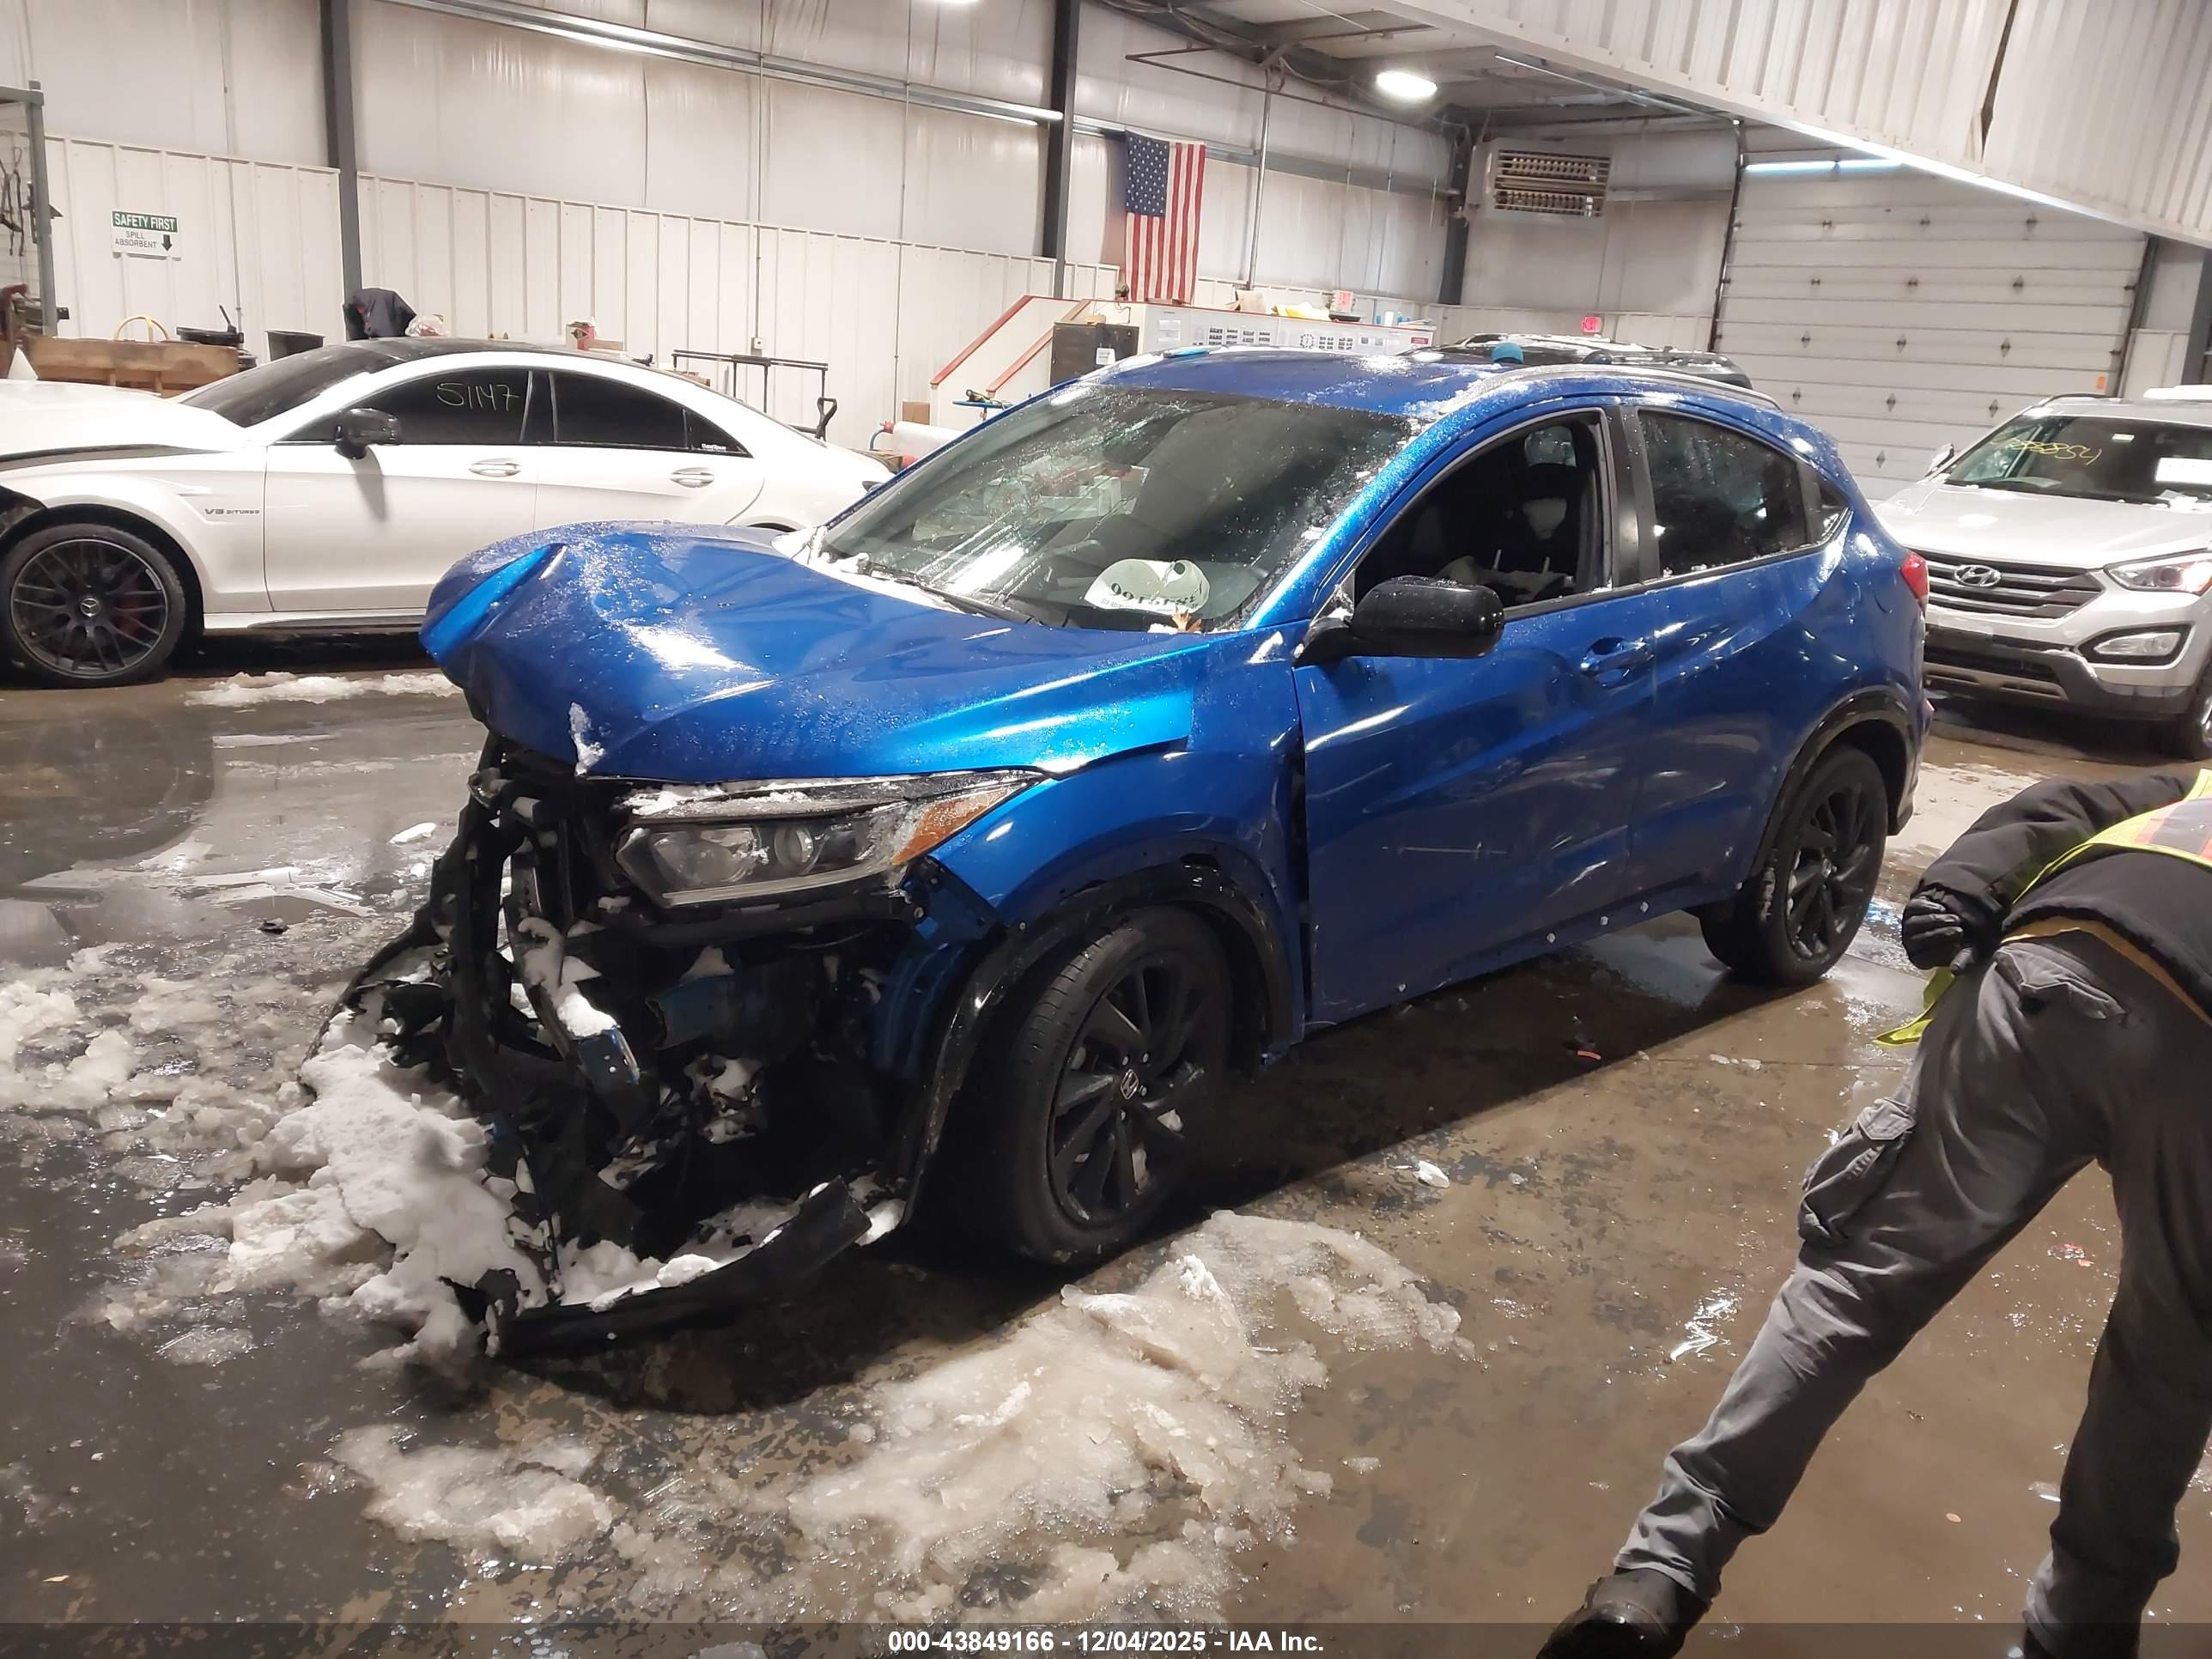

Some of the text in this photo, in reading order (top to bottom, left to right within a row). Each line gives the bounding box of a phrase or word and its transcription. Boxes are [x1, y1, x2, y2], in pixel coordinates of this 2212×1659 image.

[114, 213, 175, 231] SAFETY FIRST
[125, 231, 145, 240] SPILL
[115, 238, 157, 248] ABSORBENT
